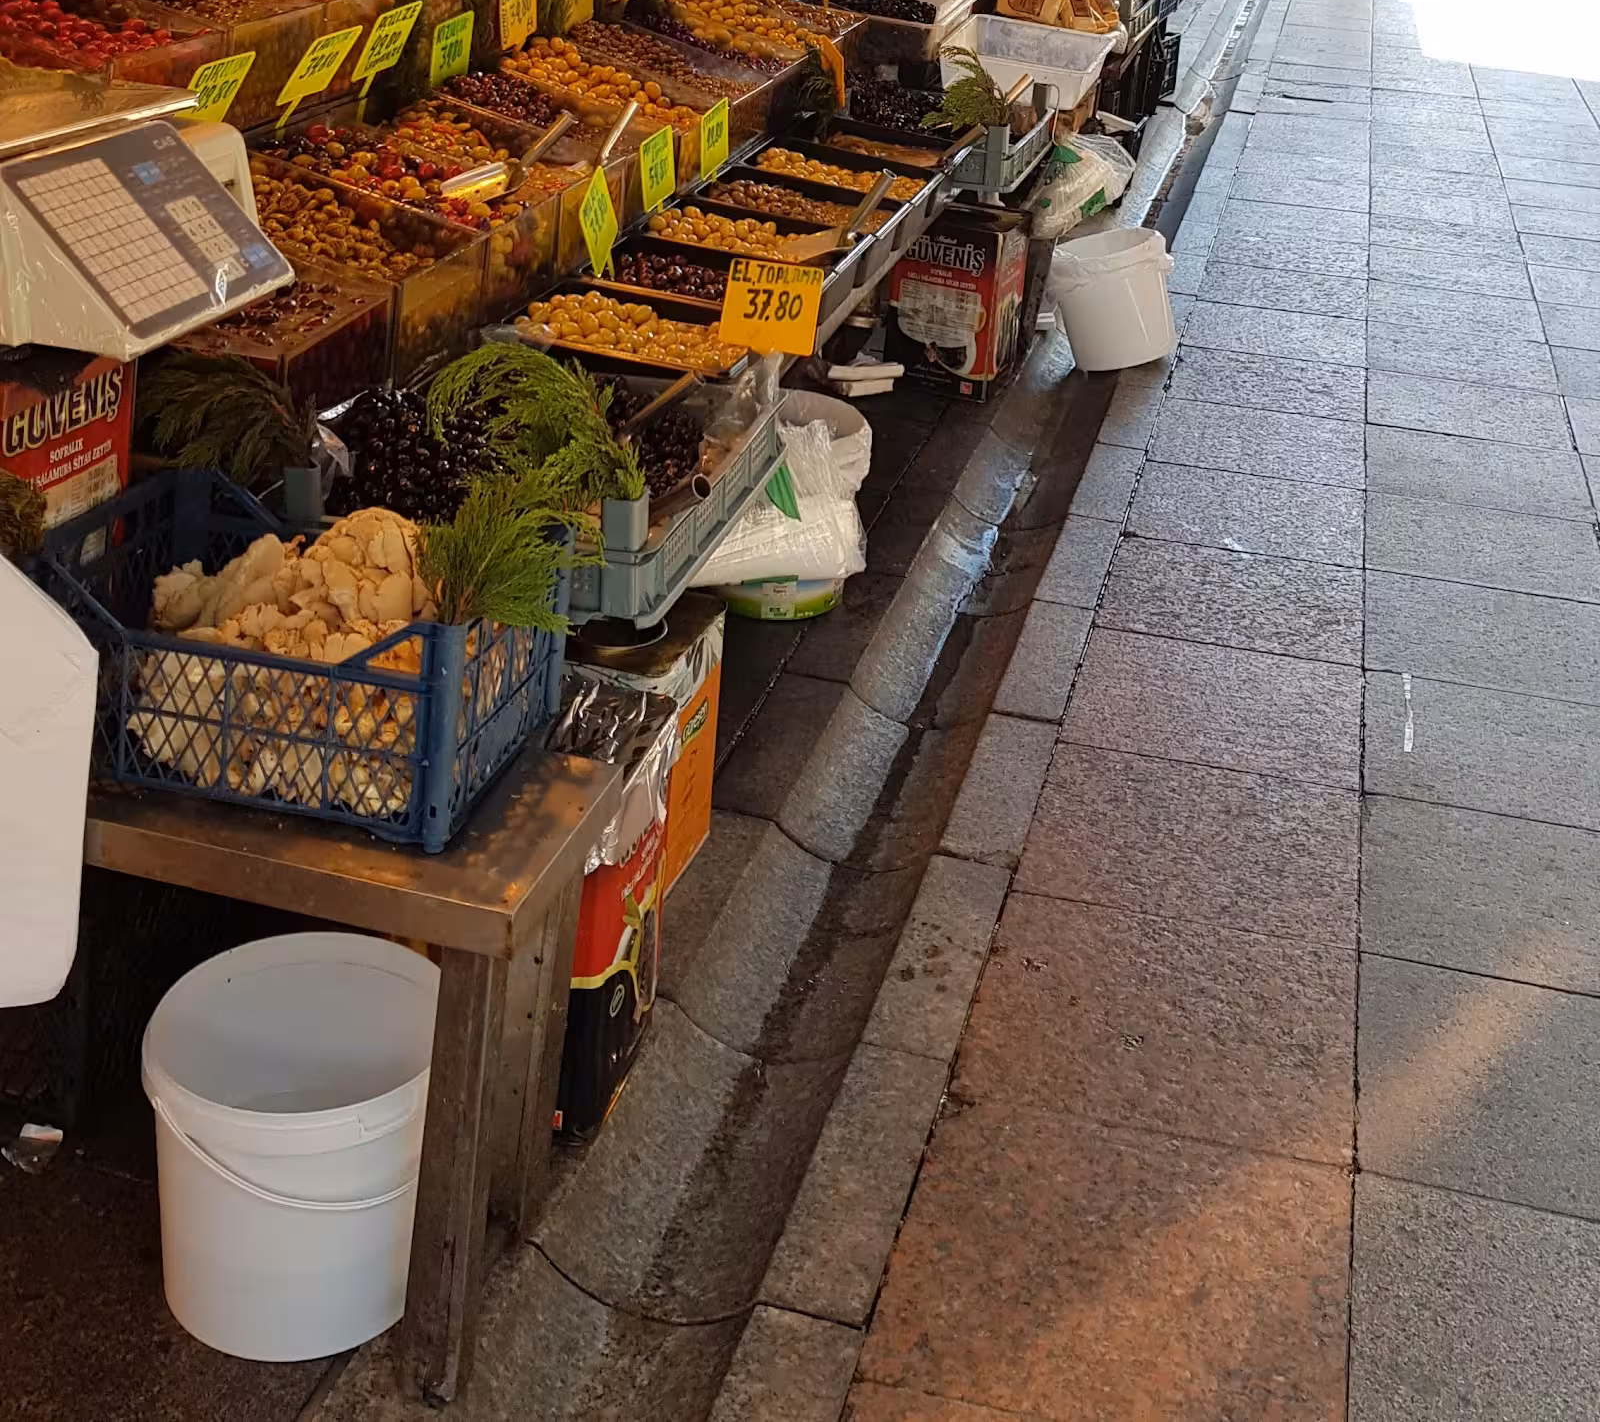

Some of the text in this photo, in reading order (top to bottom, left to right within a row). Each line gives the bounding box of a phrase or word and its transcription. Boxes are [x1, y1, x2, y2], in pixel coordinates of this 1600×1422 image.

[904, 235, 986, 277] GÜVENİŞ
[743, 288, 803, 322] 37.80
[50, 438, 84, 464] SOFRALIK
[36, 462, 72, 487] SALAMURA
